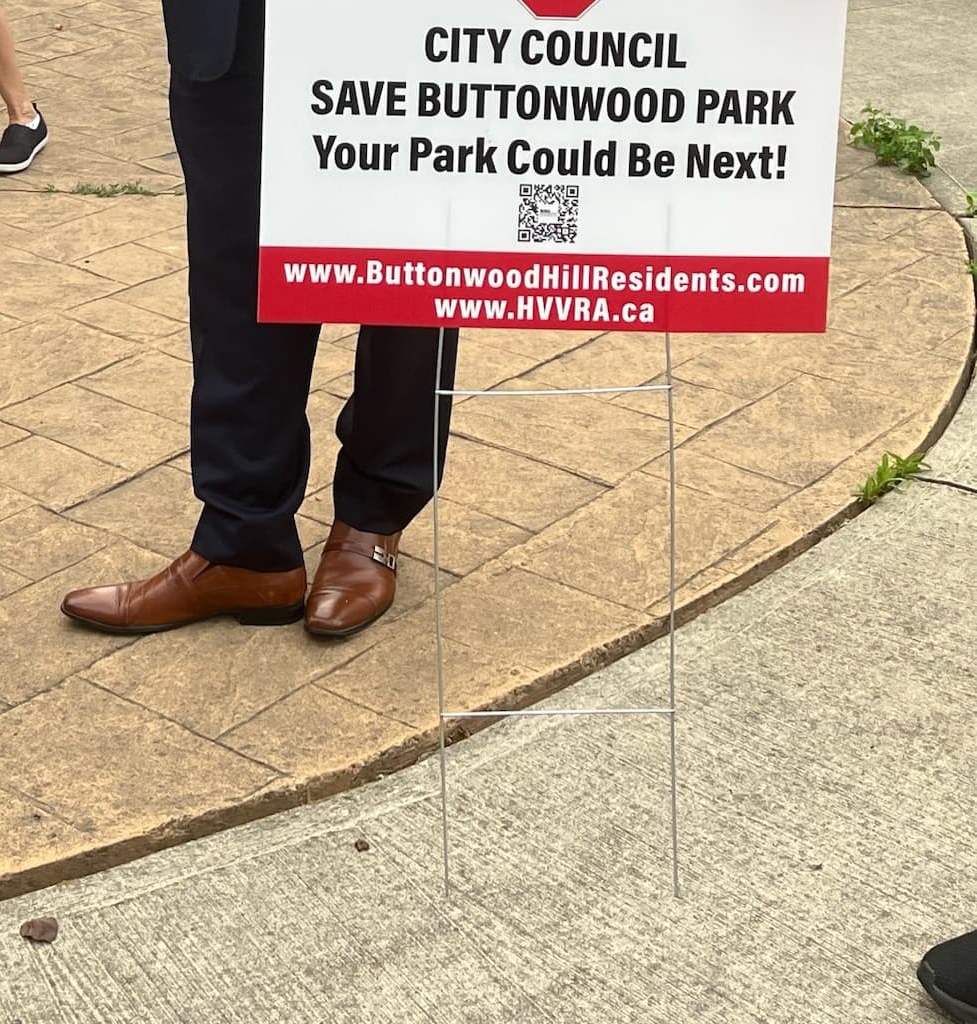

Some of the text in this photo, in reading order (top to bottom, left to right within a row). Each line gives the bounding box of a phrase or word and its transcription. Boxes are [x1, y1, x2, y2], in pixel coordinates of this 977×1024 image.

[425, 27, 686, 68] CITY COUNCIL
[311, 80, 796, 125] SAVE BUTTONWOOD PARK
[313, 135, 786, 179] Your Park Could Be Next!
[284, 260, 804, 292] www.ButtonwoodHillResidents.com
[435, 296, 654, 322] www.HVVRA.ca
